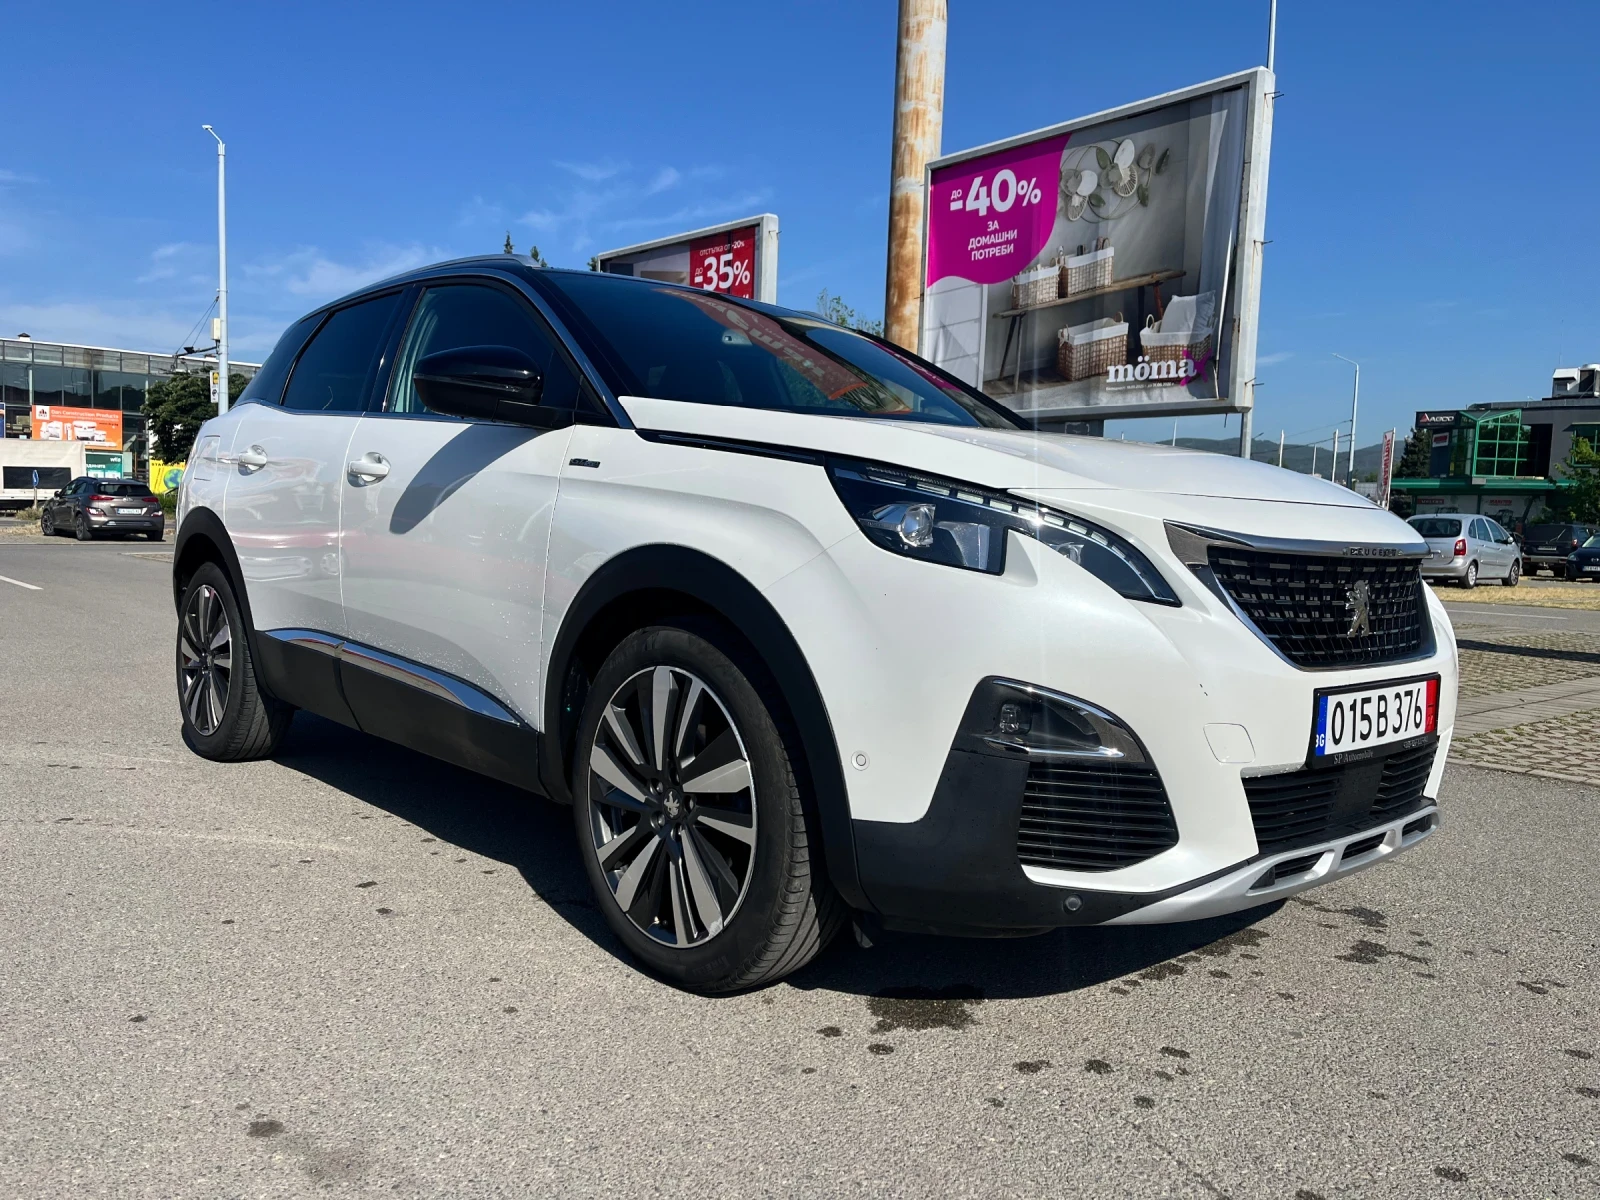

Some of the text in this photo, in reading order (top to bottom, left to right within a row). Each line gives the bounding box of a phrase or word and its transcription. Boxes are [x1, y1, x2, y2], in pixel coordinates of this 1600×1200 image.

[949, 167, 1042, 216] -40%
[987, 220, 999, 231] ЗА
[968, 229, 1017, 250] ДОМАШНИ
[971, 243, 1014, 262] ПОТРЕБИ
[694, 252, 751, 291] -35%
